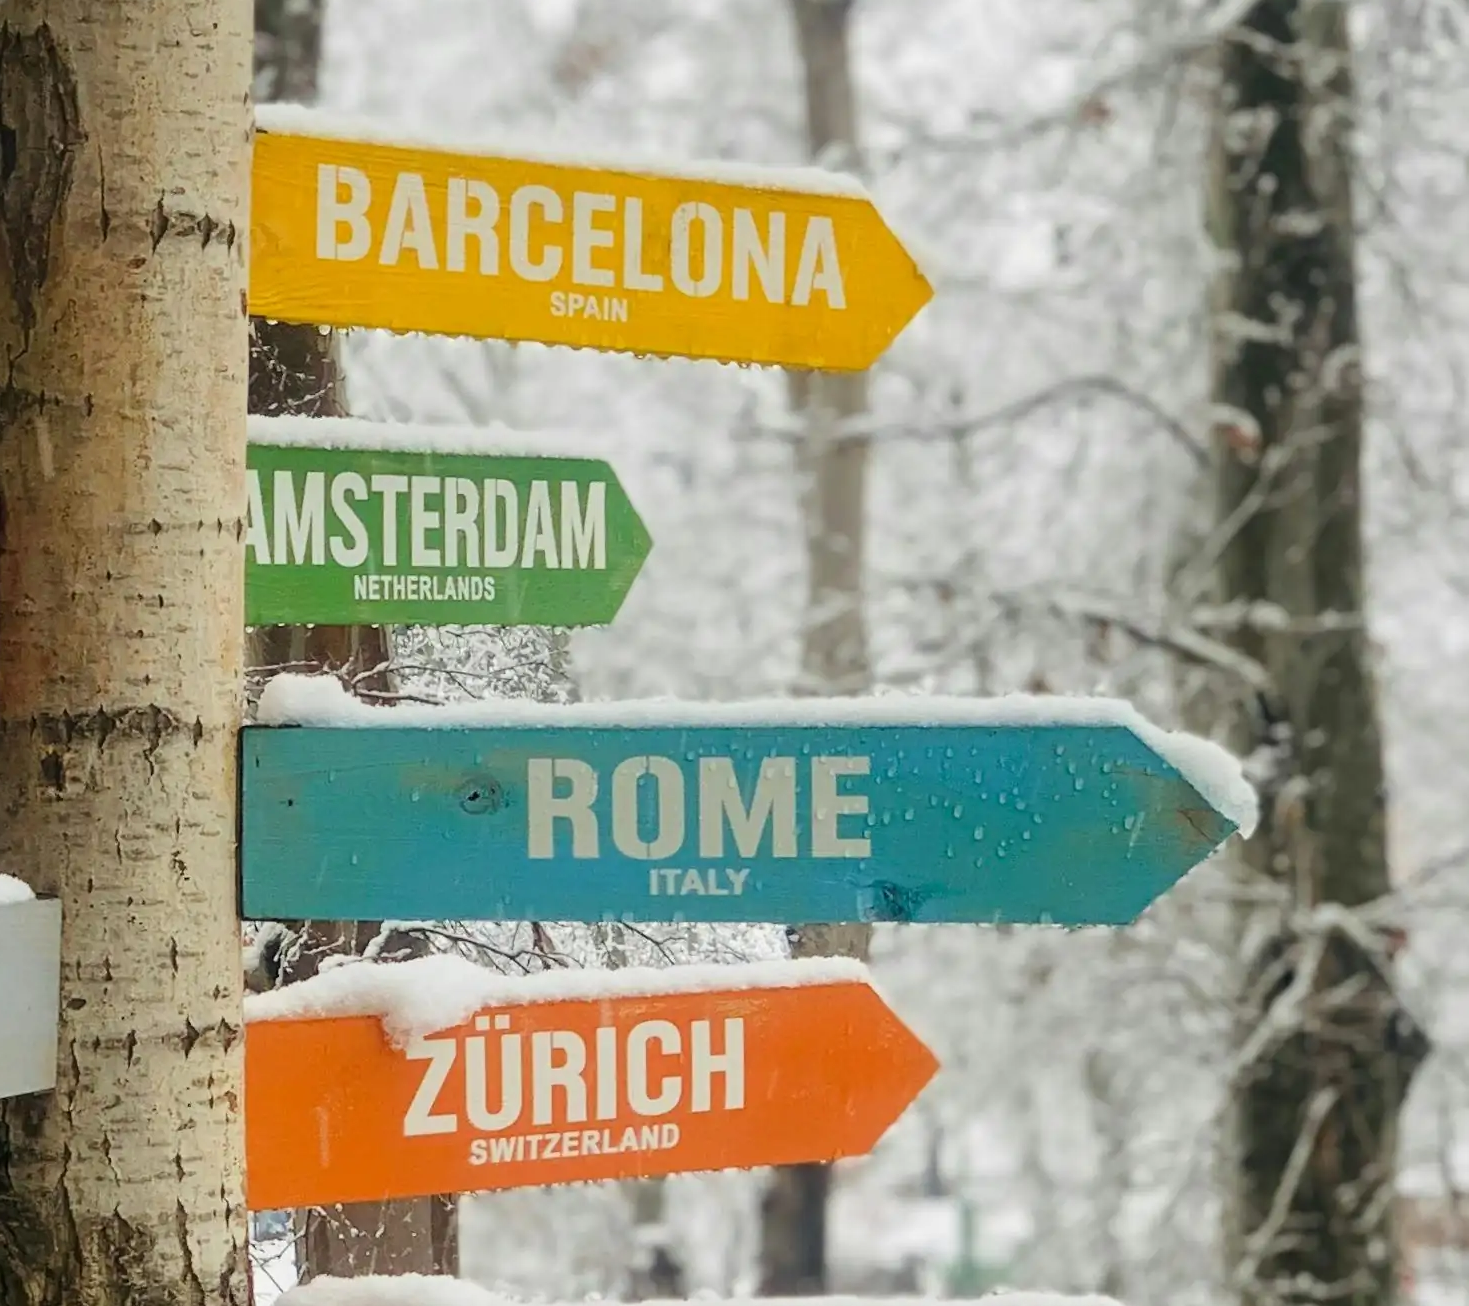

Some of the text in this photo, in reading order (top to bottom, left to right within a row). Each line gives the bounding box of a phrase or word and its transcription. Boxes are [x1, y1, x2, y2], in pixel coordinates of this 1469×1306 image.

[315, 164, 848, 310] BARCELONA
[549, 290, 629, 324] SPAIN
[245, 468, 607, 570] AMSTERDAM
[353, 574, 496, 602] NETHERLANDS
[527, 755, 872, 861] ROME
[648, 867, 751, 897] ITALY
[403, 1014, 746, 1137] ZÜRICH
[469, 1123, 680, 1166] SWITZERLAND
